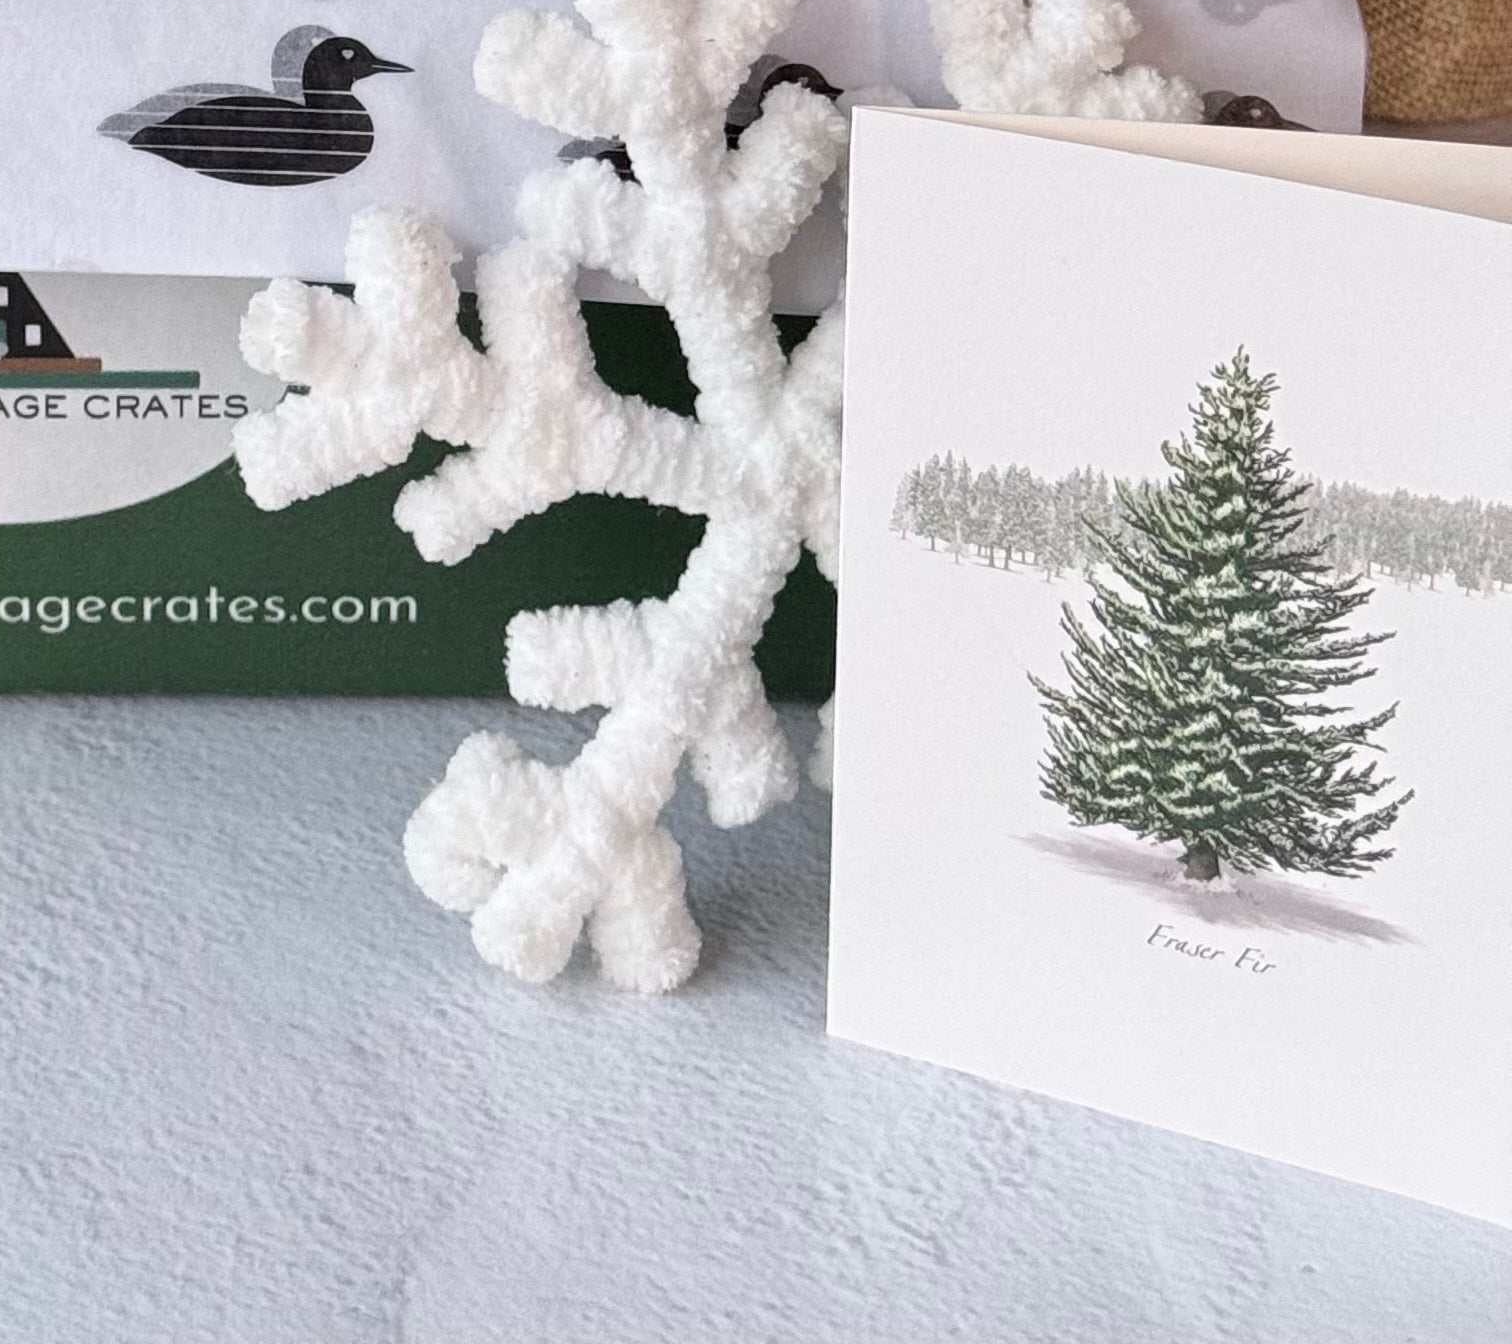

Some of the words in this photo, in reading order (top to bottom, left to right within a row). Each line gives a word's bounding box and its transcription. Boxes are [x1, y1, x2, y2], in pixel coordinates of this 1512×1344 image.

[82, 393, 250, 420] CRATES
[1147, 924, 1225, 960] Fraser
[1234, 947, 1277, 973] Fir
